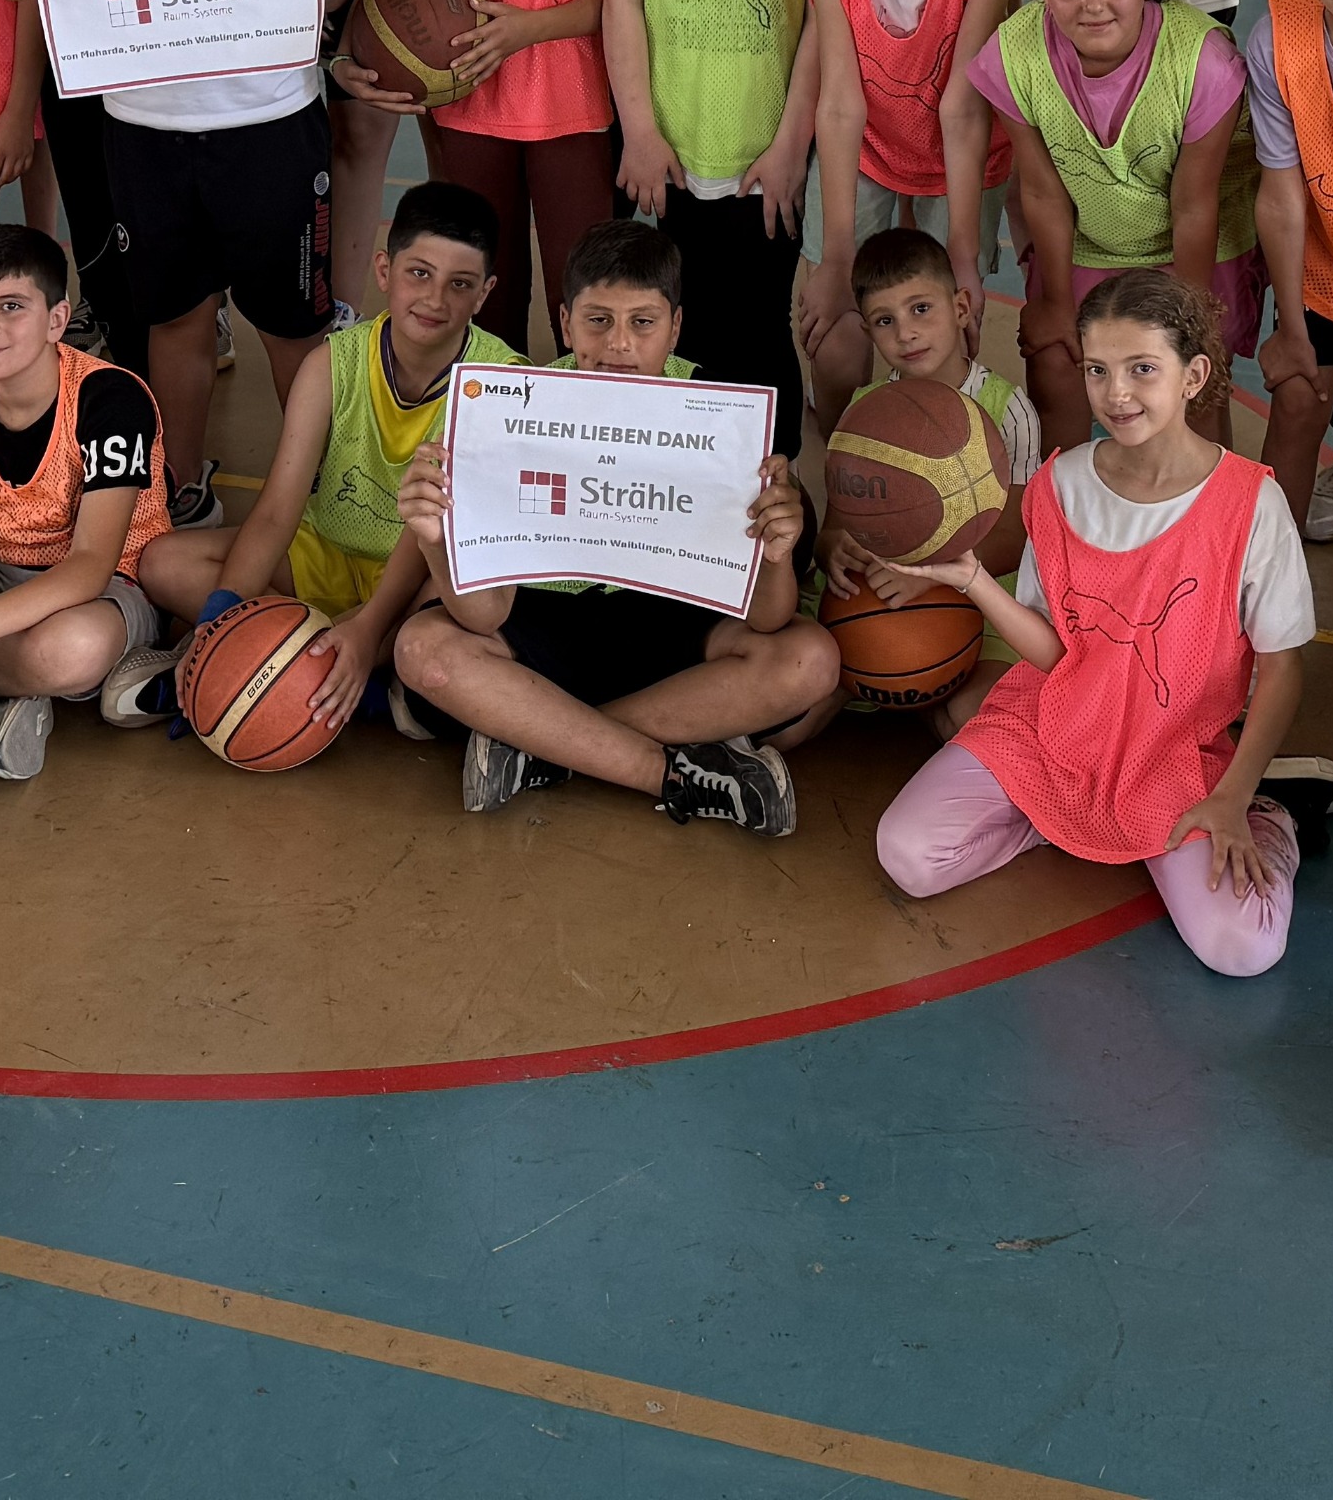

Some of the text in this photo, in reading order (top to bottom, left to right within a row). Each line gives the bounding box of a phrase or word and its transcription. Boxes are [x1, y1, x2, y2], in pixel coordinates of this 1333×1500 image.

[163, 6, 233, 22] Raum-Systeme
[61, 53, 78, 61] von
[129, 42, 161, 54] Syrien
[169, 37, 193, 48] nach
[255, 23, 316, 38] Deutschland
[484, 383, 524, 397] MBA
[504, 418, 716, 451] VIELEN LIEBEN DANK
[80, 433, 147, 483] USA
[597, 454, 616, 465] AN
[579, 476, 693, 514] Strähle
[579, 507, 659, 525] Raum-Systeme
[458, 537, 477, 548] von
[534, 533, 570, 546] Syrien
[579, 536, 607, 547] nach
[678, 548, 747, 573] Deutschland
[853, 668, 966, 706] Wilson
